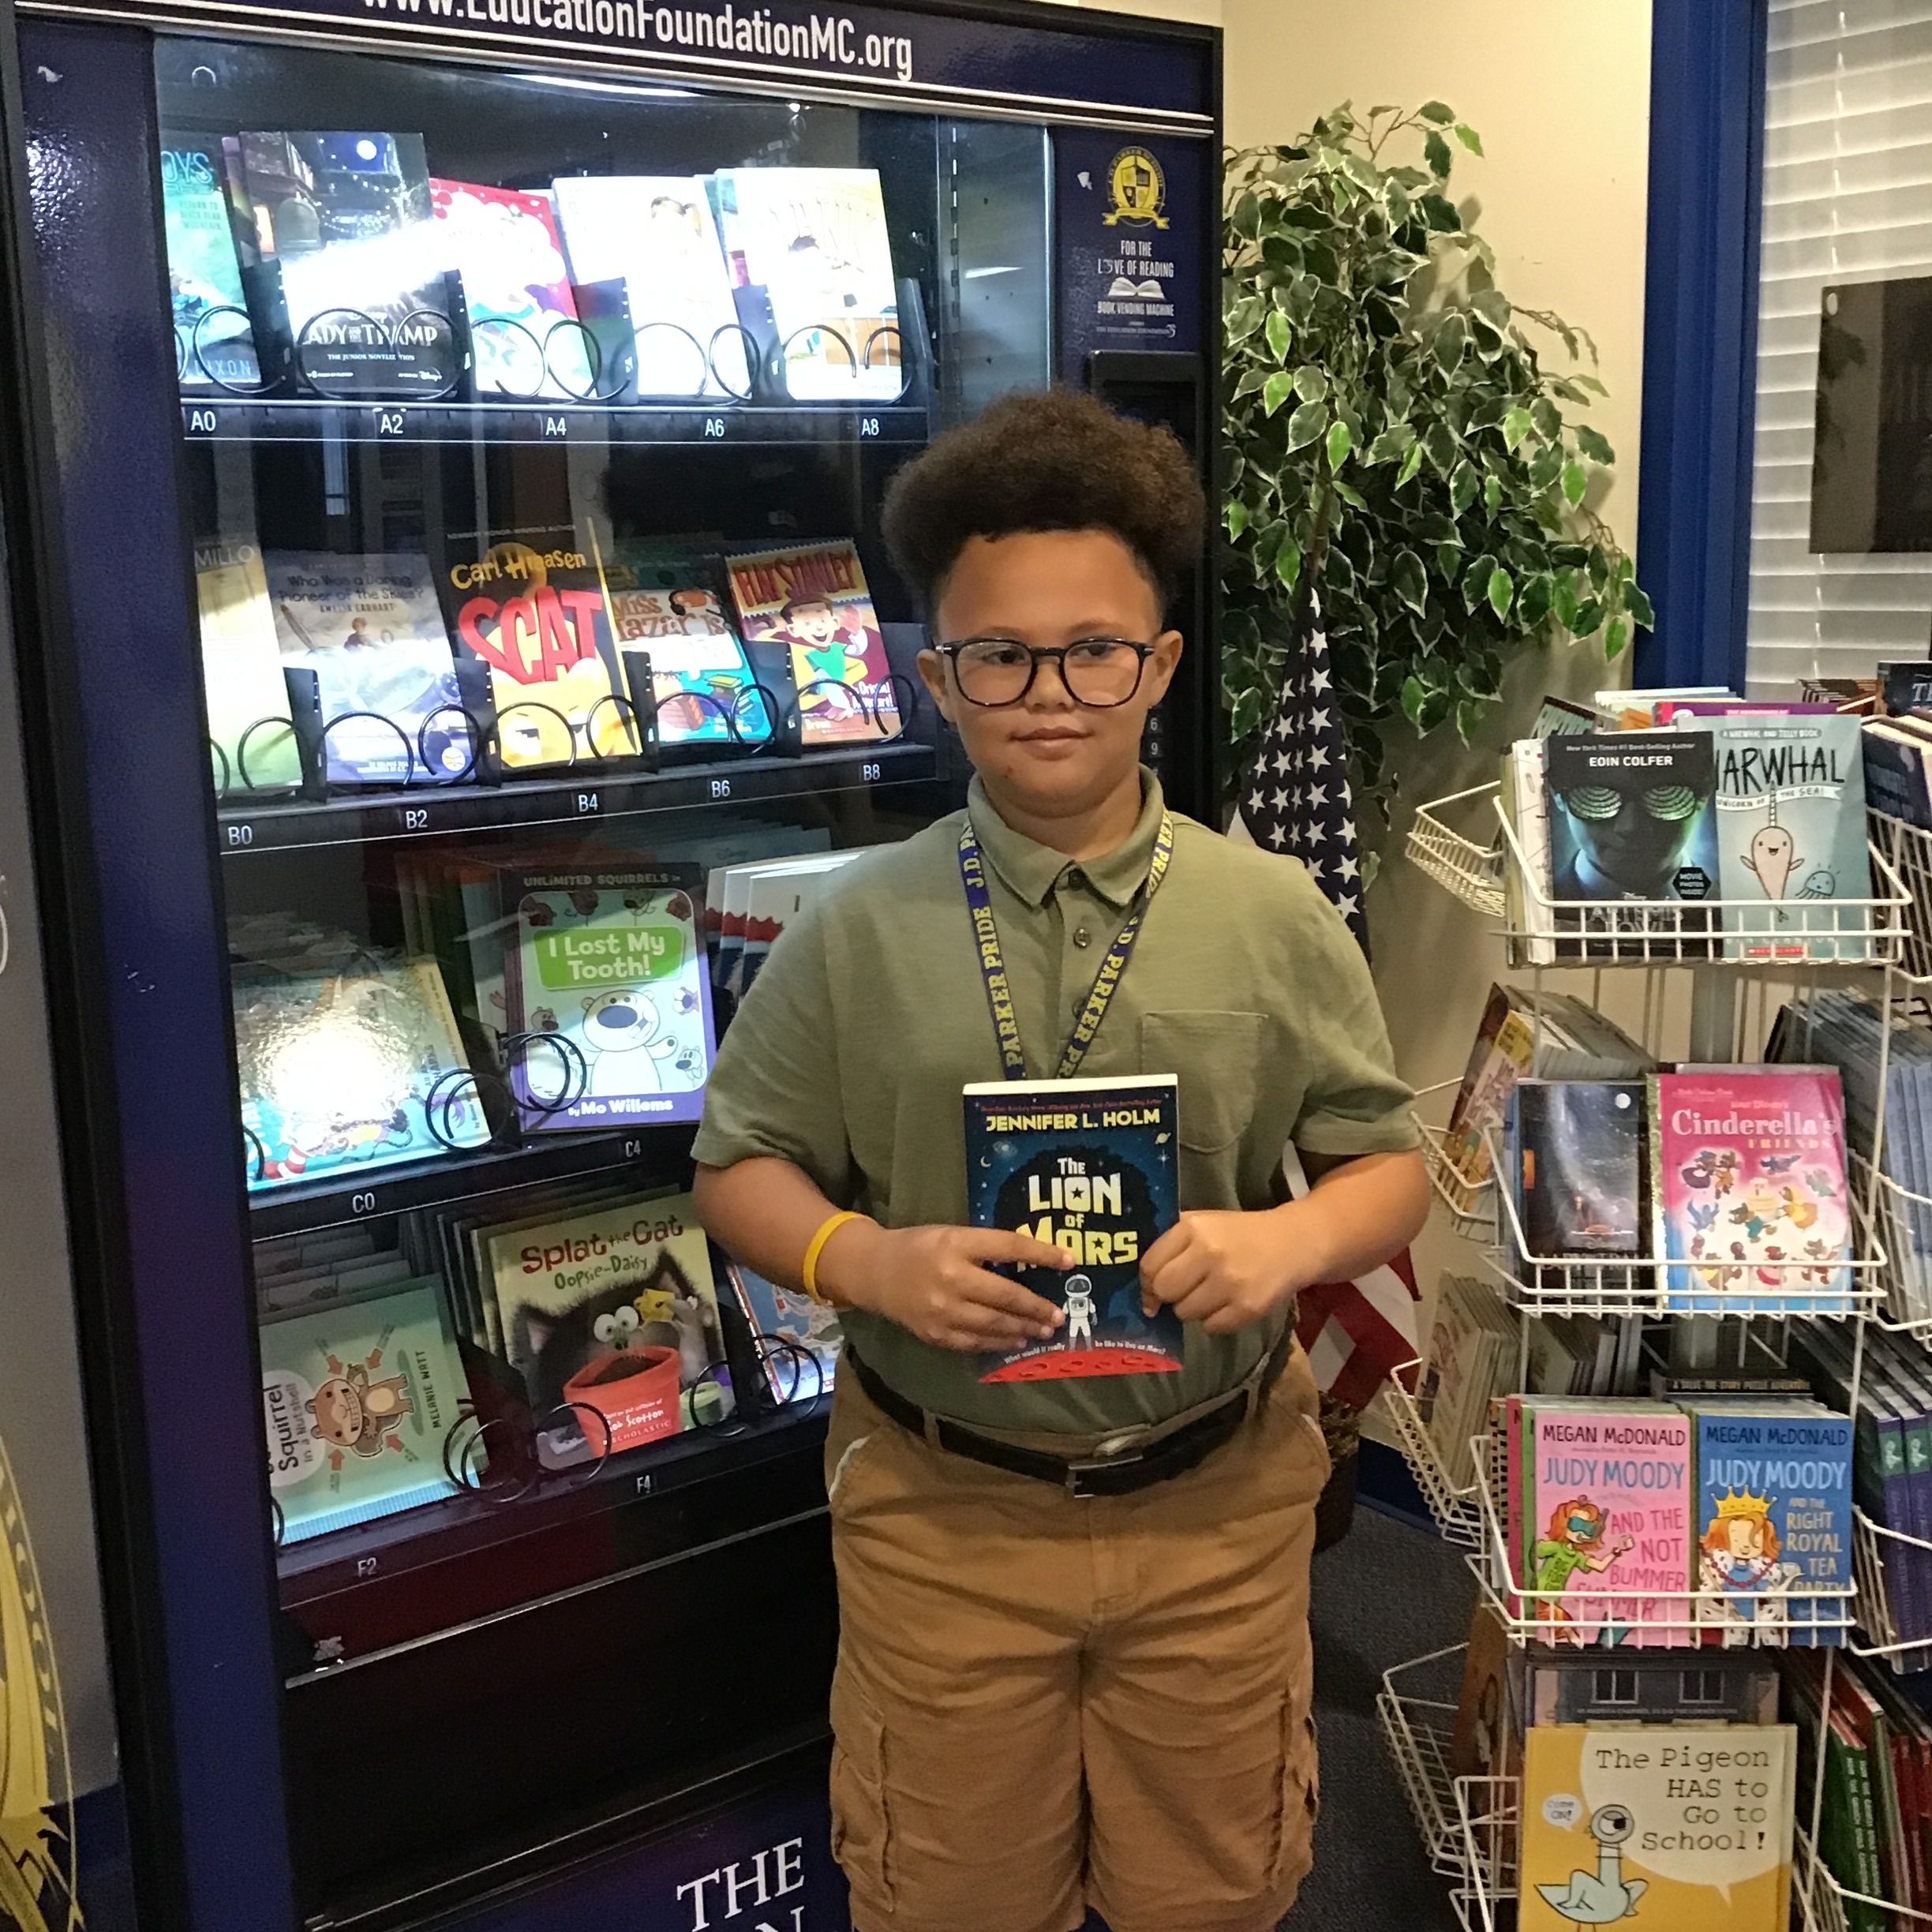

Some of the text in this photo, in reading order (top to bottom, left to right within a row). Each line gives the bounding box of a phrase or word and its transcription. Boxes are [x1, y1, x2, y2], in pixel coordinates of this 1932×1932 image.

[364, 0, 912, 81] w.ducationFoundationMC.org
[1121, 240, 1152, 258] FOR THE
[1126, 260, 1138, 276] OF
[1139, 260, 1174, 278] READING
[368, 353, 416, 361] NOVELIZTION
[190, 410, 216, 432] A0
[380, 414, 404, 435] A2
[545, 417, 567, 436] A4
[705, 419, 724, 437] A6
[861, 418, 880, 436] A8
[450, 548, 504, 590] Carl
[611, 593, 663, 620] Miss
[459, 585, 605, 685] SCAT
[1150, 717, 1159, 732] 6
[1150, 742, 1159, 756] 9
[1671, 742, 1695, 751] Author
[1589, 754, 1674, 768] EOIN COLFER
[863, 764, 881, 782] B8
[711, 781, 731, 797] B6
[578, 793, 599, 813] B4
[406, 809, 429, 829] B2
[228, 826, 253, 846] B0
[523, 872, 669, 887] UNLIMITED SQUIRRELS
[1679, 873, 1704, 882] MOVIE
[549, 931, 665, 958] I Lost My
[567, 954, 652, 981] Tooth!
[962, 851, 1024, 1068] PARKER PRIDE J.D.
[1076, 953, 1125, 1044] PARKER
[580, 1101, 607, 1117] Mo
[608, 1097, 674, 1114] Willems
[986, 1108, 1161, 1133] JENNIFER L. HOLM
[1671, 1108, 1835, 1136] Cinderella's
[625, 1140, 642, 1159] C4
[352, 1192, 376, 1214] C0
[1028, 1172, 1122, 1217] LION
[520, 1214, 684, 1275] Splat the Cat
[553, 1254, 649, 1290] Oopsie-Daisy
[414, 1350, 442, 1429] MELANIE WATT
[263, 1383, 300, 1473] Squirrel
[625, 1410, 665, 1428] Scotton
[1542, 1424, 1687, 1447] MEGAN McDONALD
[1705, 1425, 1849, 1446] MEGAN McDONALD
[636, 1474, 651, 1493] F4
[1542, 1456, 1686, 1490] JUDY MOODY
[1705, 1458, 1847, 1490] JUDY MOODY
[1610, 1507, 1685, 1536] AND THE
[1786, 1511, 1834, 1530] RIGHT
[1640, 1537, 1683, 1564] NOT
[1786, 1532, 1844, 1552] ROYAL
[358, 1557, 378, 1578] F2
[1808, 1556, 1838, 1577] TEA
[1608, 1563, 1687, 1593] BUMMER
[1595, 1745, 1769, 1773] The Pigeon
[1665, 1778, 1769, 1799] HAS to
[1683, 1805, 1768, 1825] Go to
[1641, 1830, 1765, 1852] School!
[676, 1836, 805, 1932] THE
